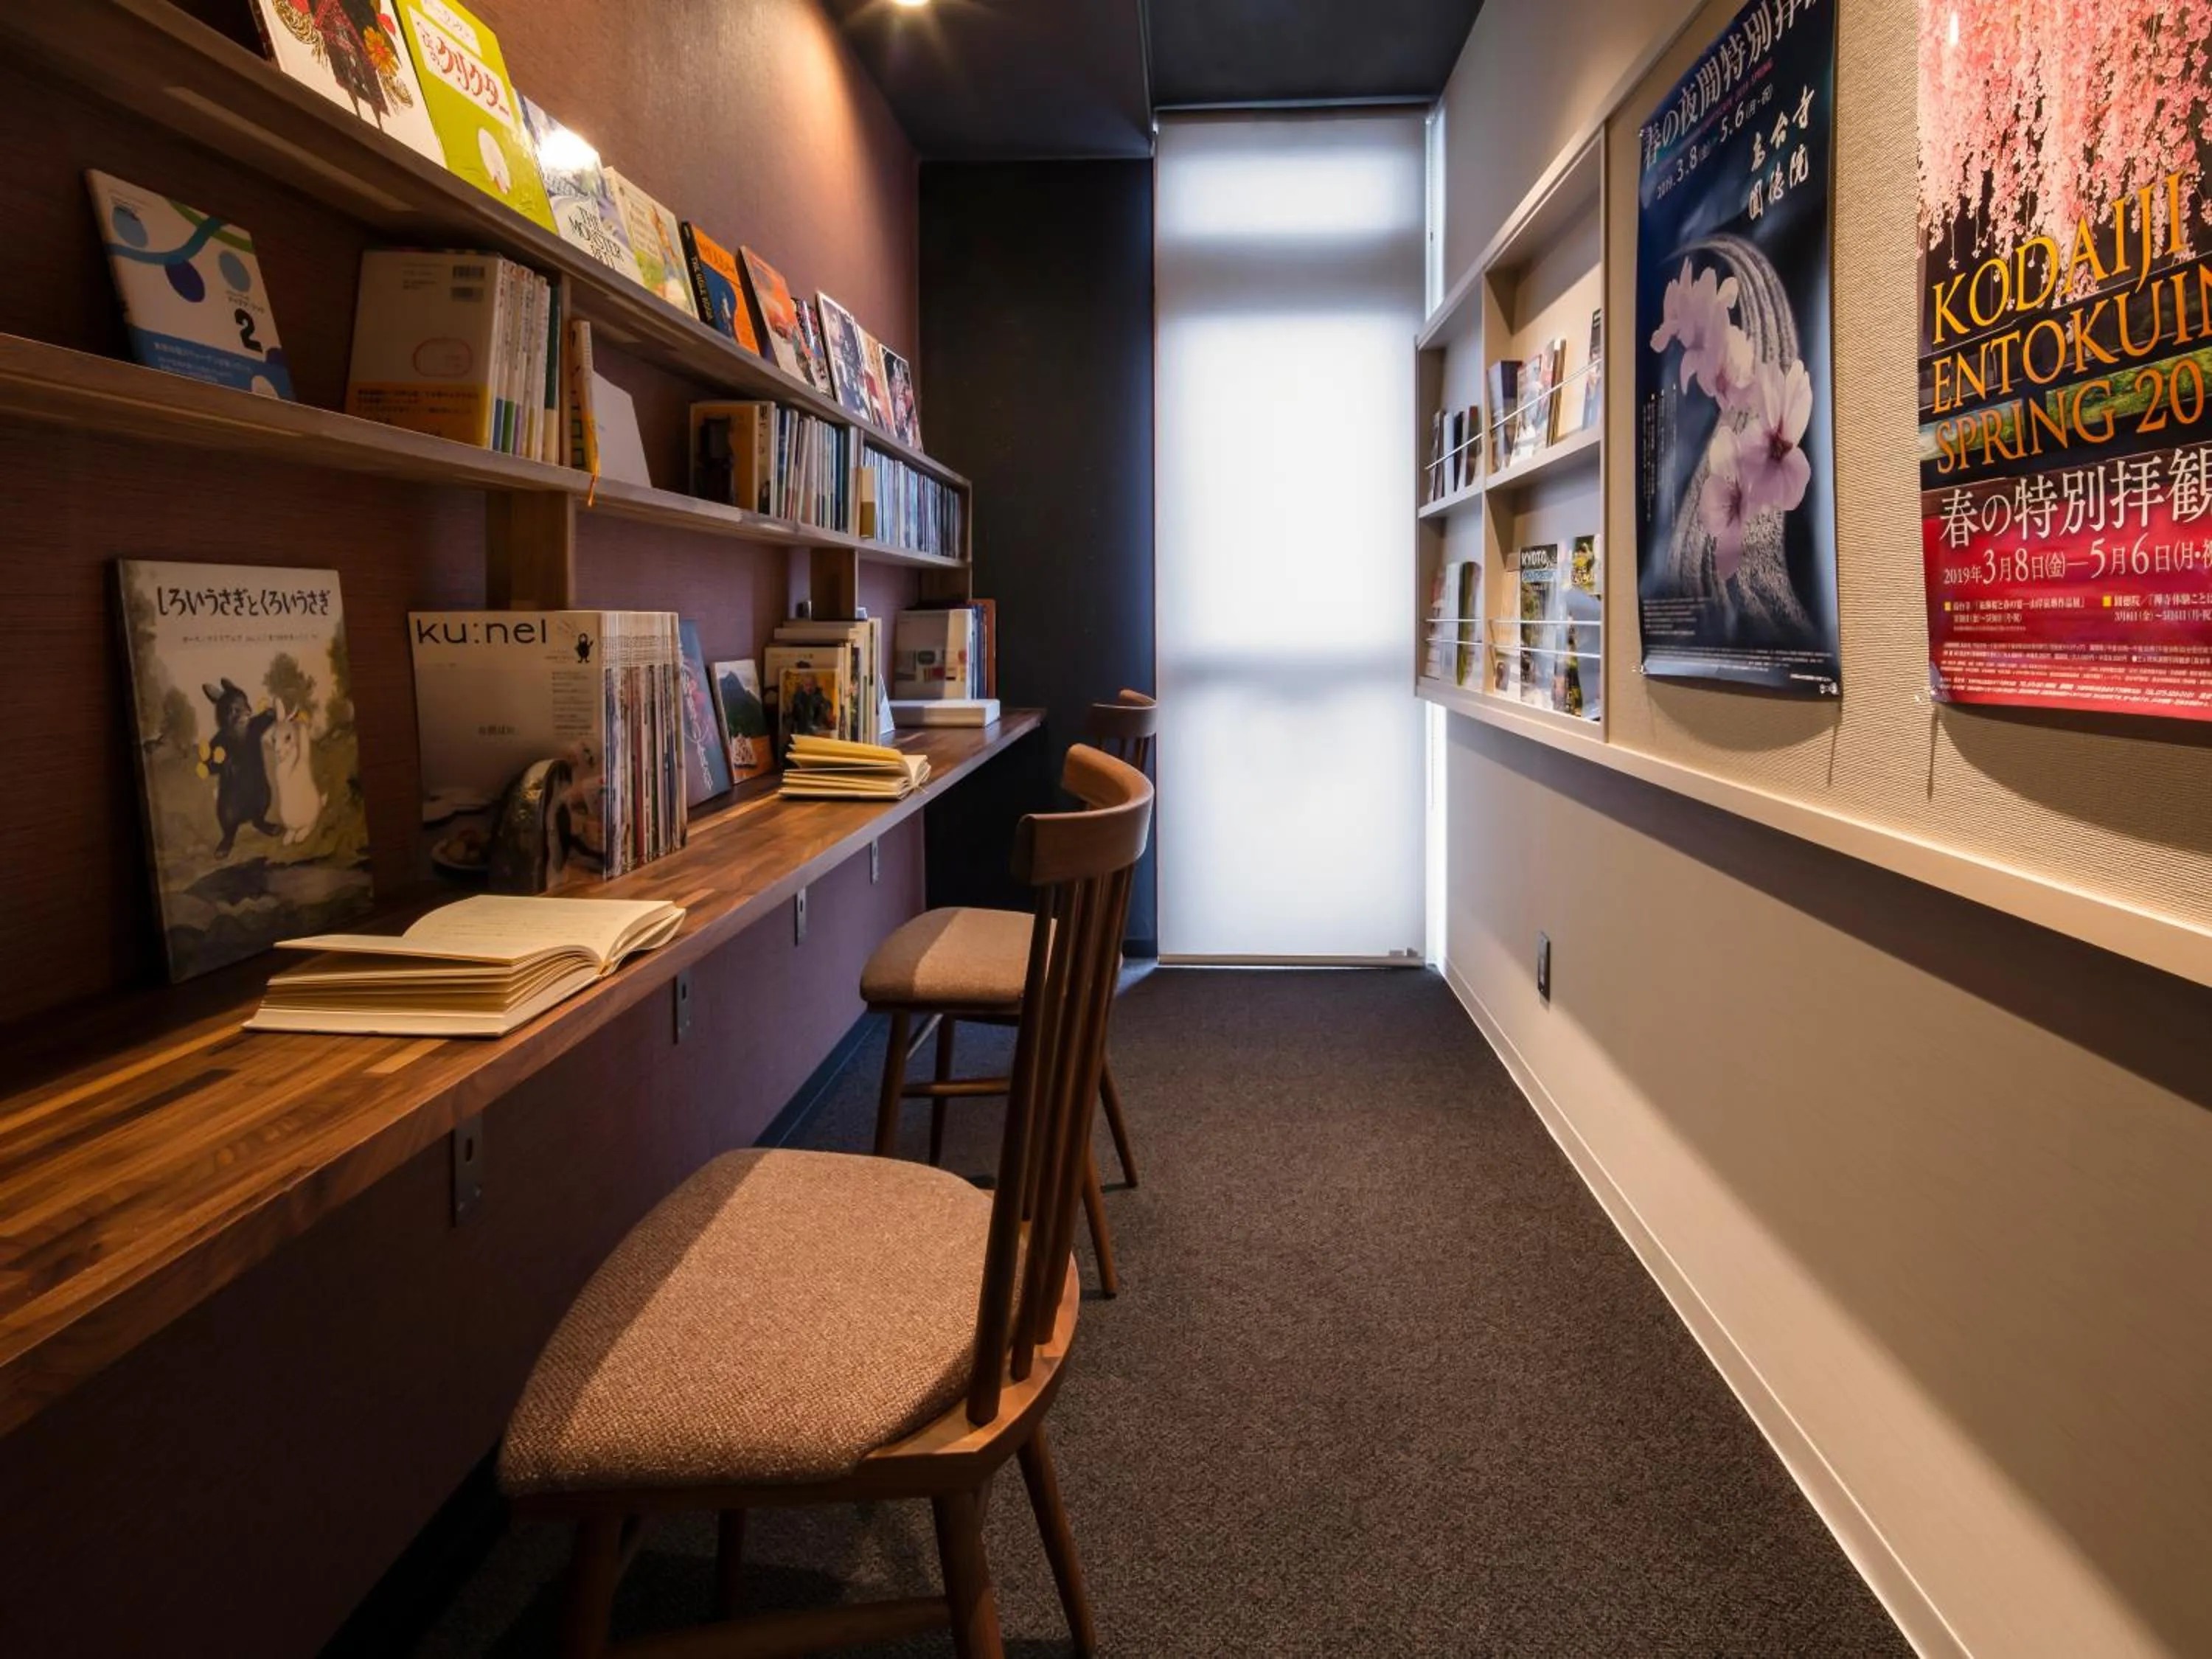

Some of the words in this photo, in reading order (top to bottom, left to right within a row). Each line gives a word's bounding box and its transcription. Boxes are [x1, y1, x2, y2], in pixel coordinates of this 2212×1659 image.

[1932, 170, 2186, 345] KODAIJI
[234, 307, 263, 355] 2
[1935, 380, 2115, 473] SPRING
[2135, 358, 2205, 434] 20
[1939, 448, 2212, 549] 春の特別拝観
[157, 587, 331, 616] しろいうさぎとくろいうさぎ
[417, 618, 547, 645] ku:nel
